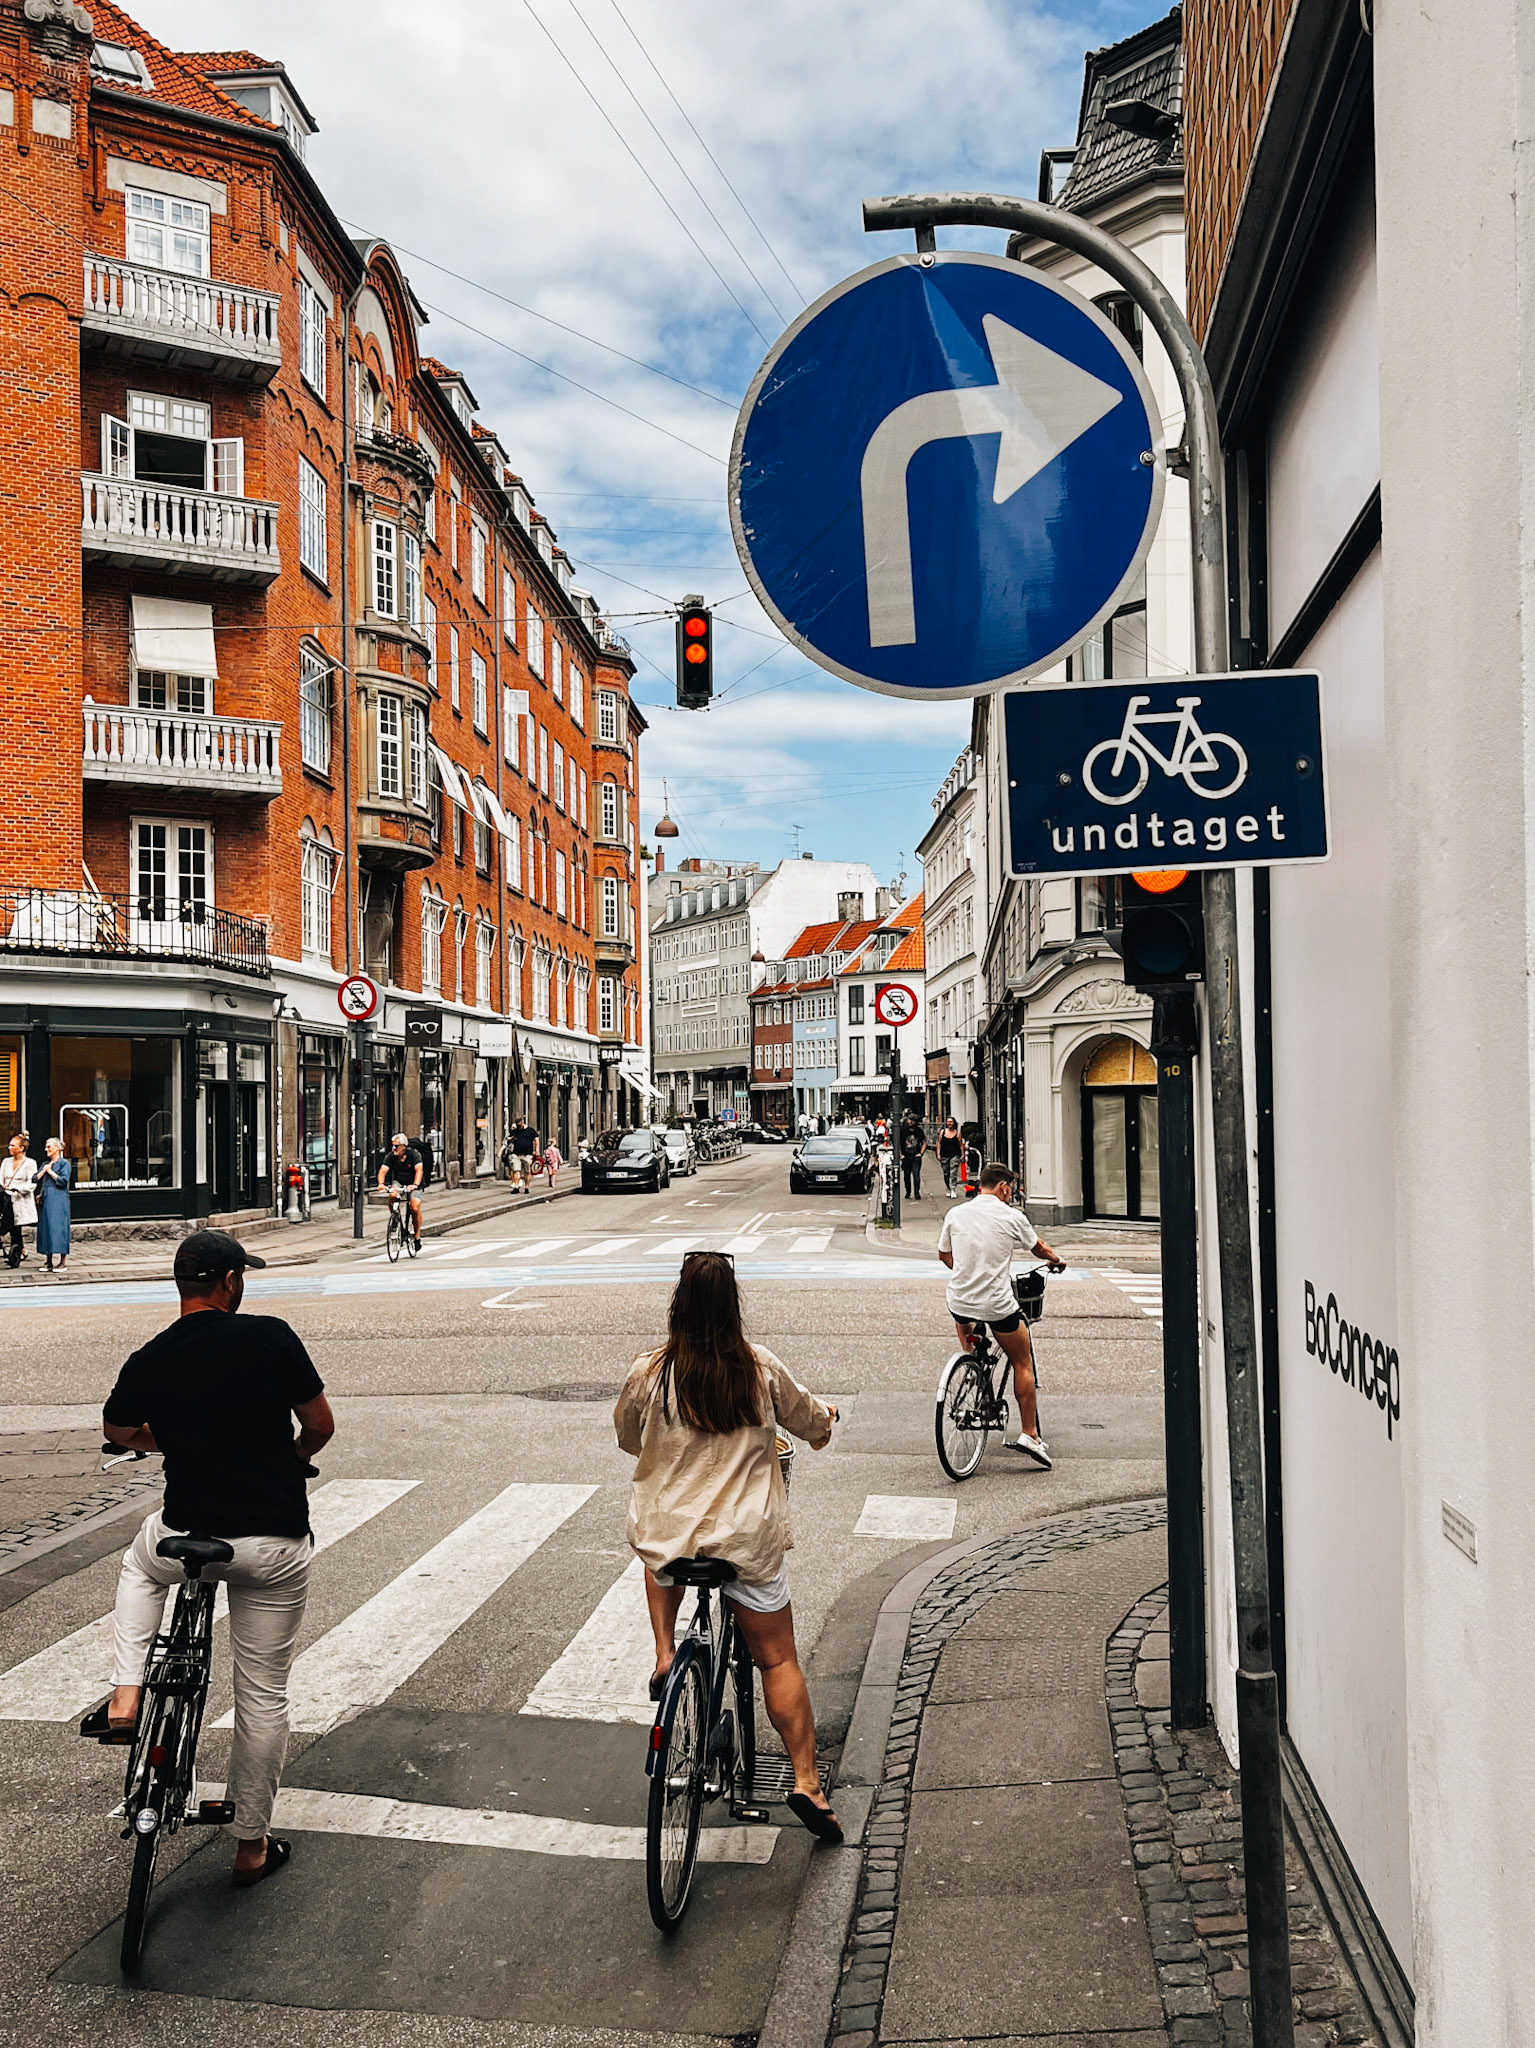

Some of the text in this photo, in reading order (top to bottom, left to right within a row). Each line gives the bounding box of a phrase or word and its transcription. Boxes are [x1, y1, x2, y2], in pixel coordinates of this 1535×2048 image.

[1052, 805, 1286, 853] undtaget
[601, 1049, 620, 1060] BAR
[1163, 1064, 1181, 1078] 10
